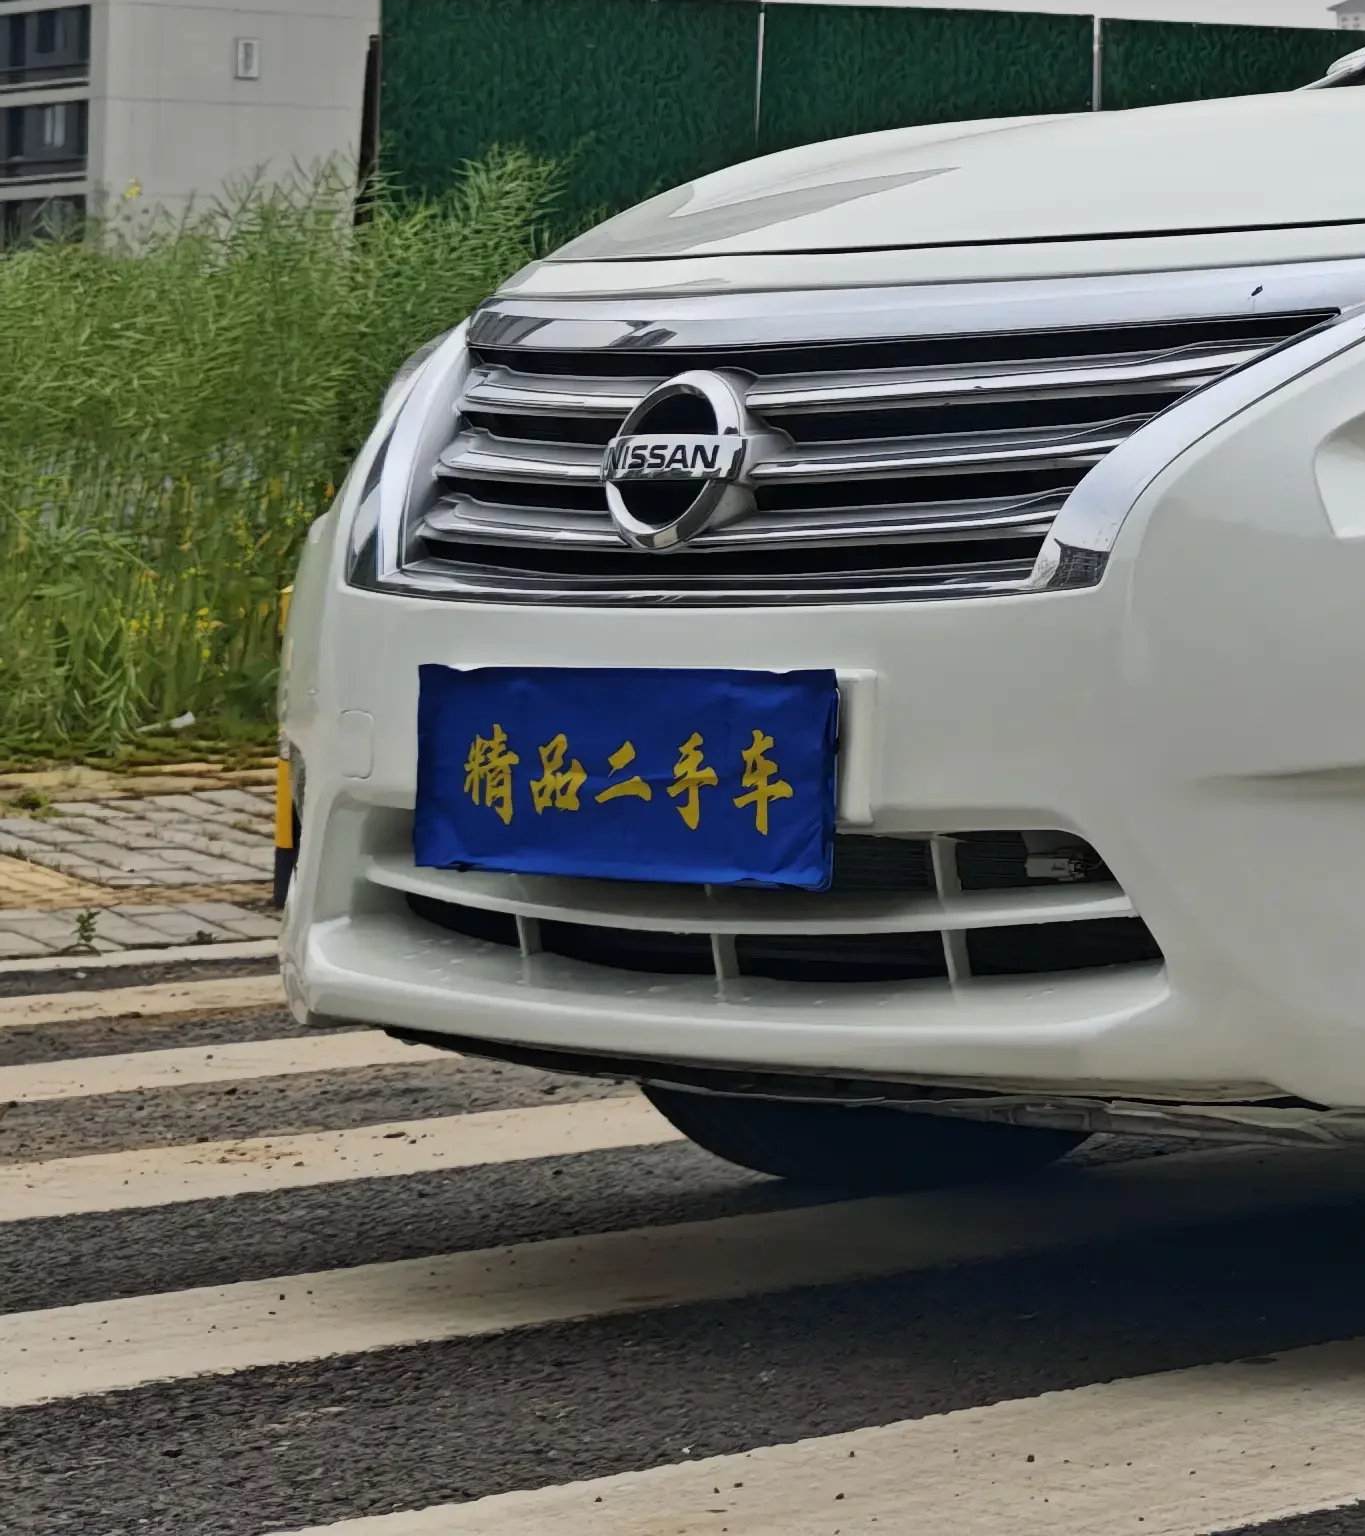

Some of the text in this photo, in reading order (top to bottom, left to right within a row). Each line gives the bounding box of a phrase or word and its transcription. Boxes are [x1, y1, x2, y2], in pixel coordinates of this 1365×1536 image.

[605, 444, 720, 471] NISSAN
[463, 724, 793, 835] 精品二手车
